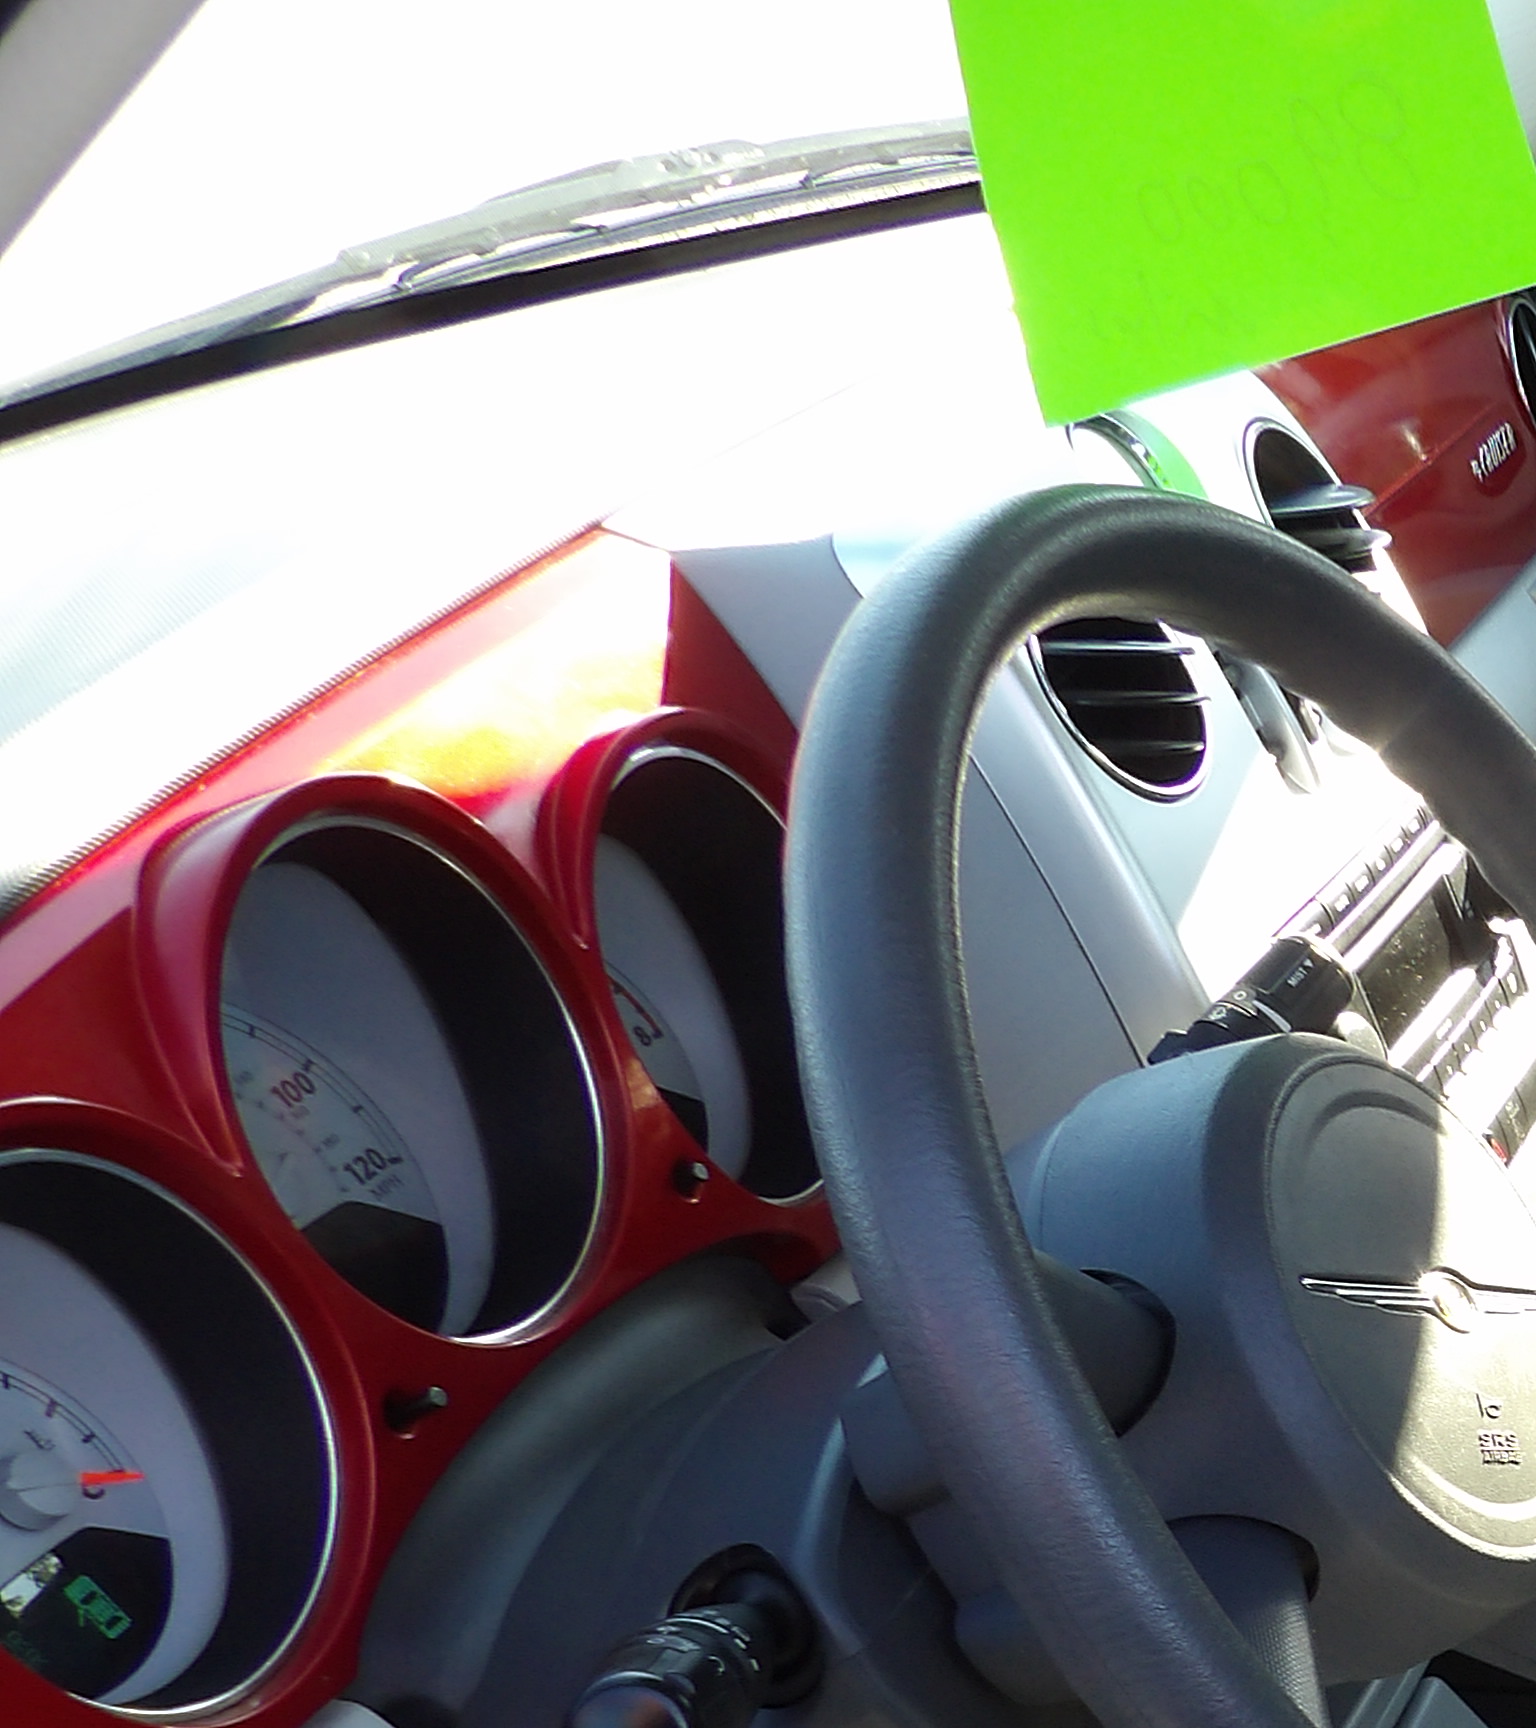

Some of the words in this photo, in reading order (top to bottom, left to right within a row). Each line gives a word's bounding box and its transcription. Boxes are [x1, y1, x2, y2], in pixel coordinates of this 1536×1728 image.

[1479, 422, 1517, 477] CRUISER
[1287, 966, 1308, 987] MIST
[633, 1025, 652, 1047] 8
[270, 1071, 316, 1108] 100
[342, 1147, 388, 1186] 120
